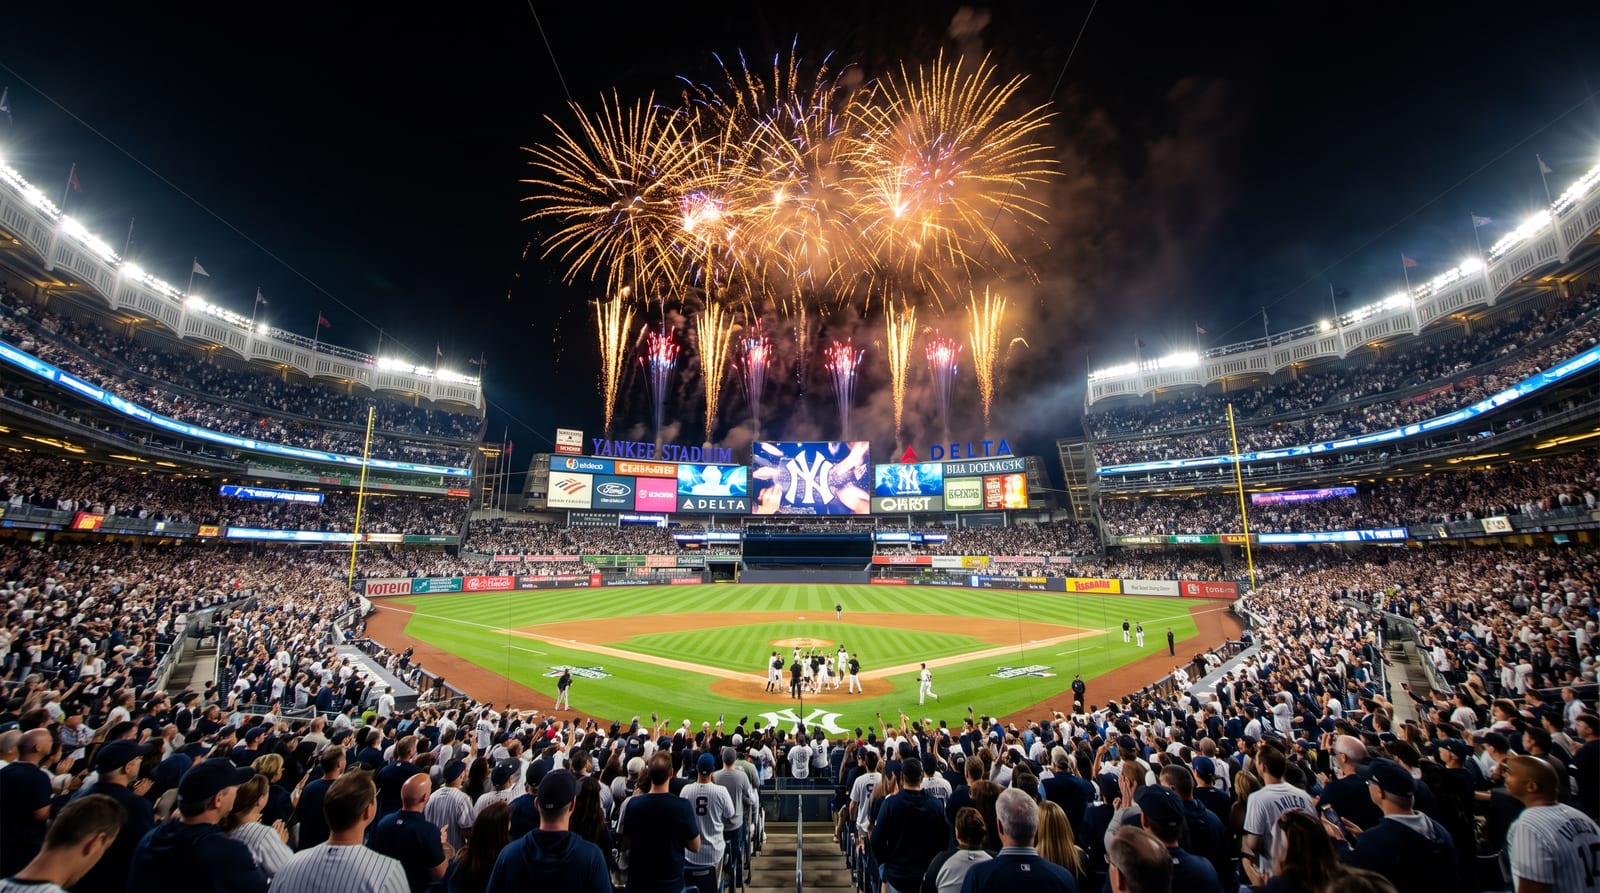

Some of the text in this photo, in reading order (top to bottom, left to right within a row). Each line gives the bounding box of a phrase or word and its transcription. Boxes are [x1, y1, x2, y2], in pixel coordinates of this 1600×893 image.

[592, 438, 655, 459] YANKEE
[930, 439, 1012, 461] DELTA
[603, 485, 625, 495] Ford
[698, 499, 745, 510] DELTA
